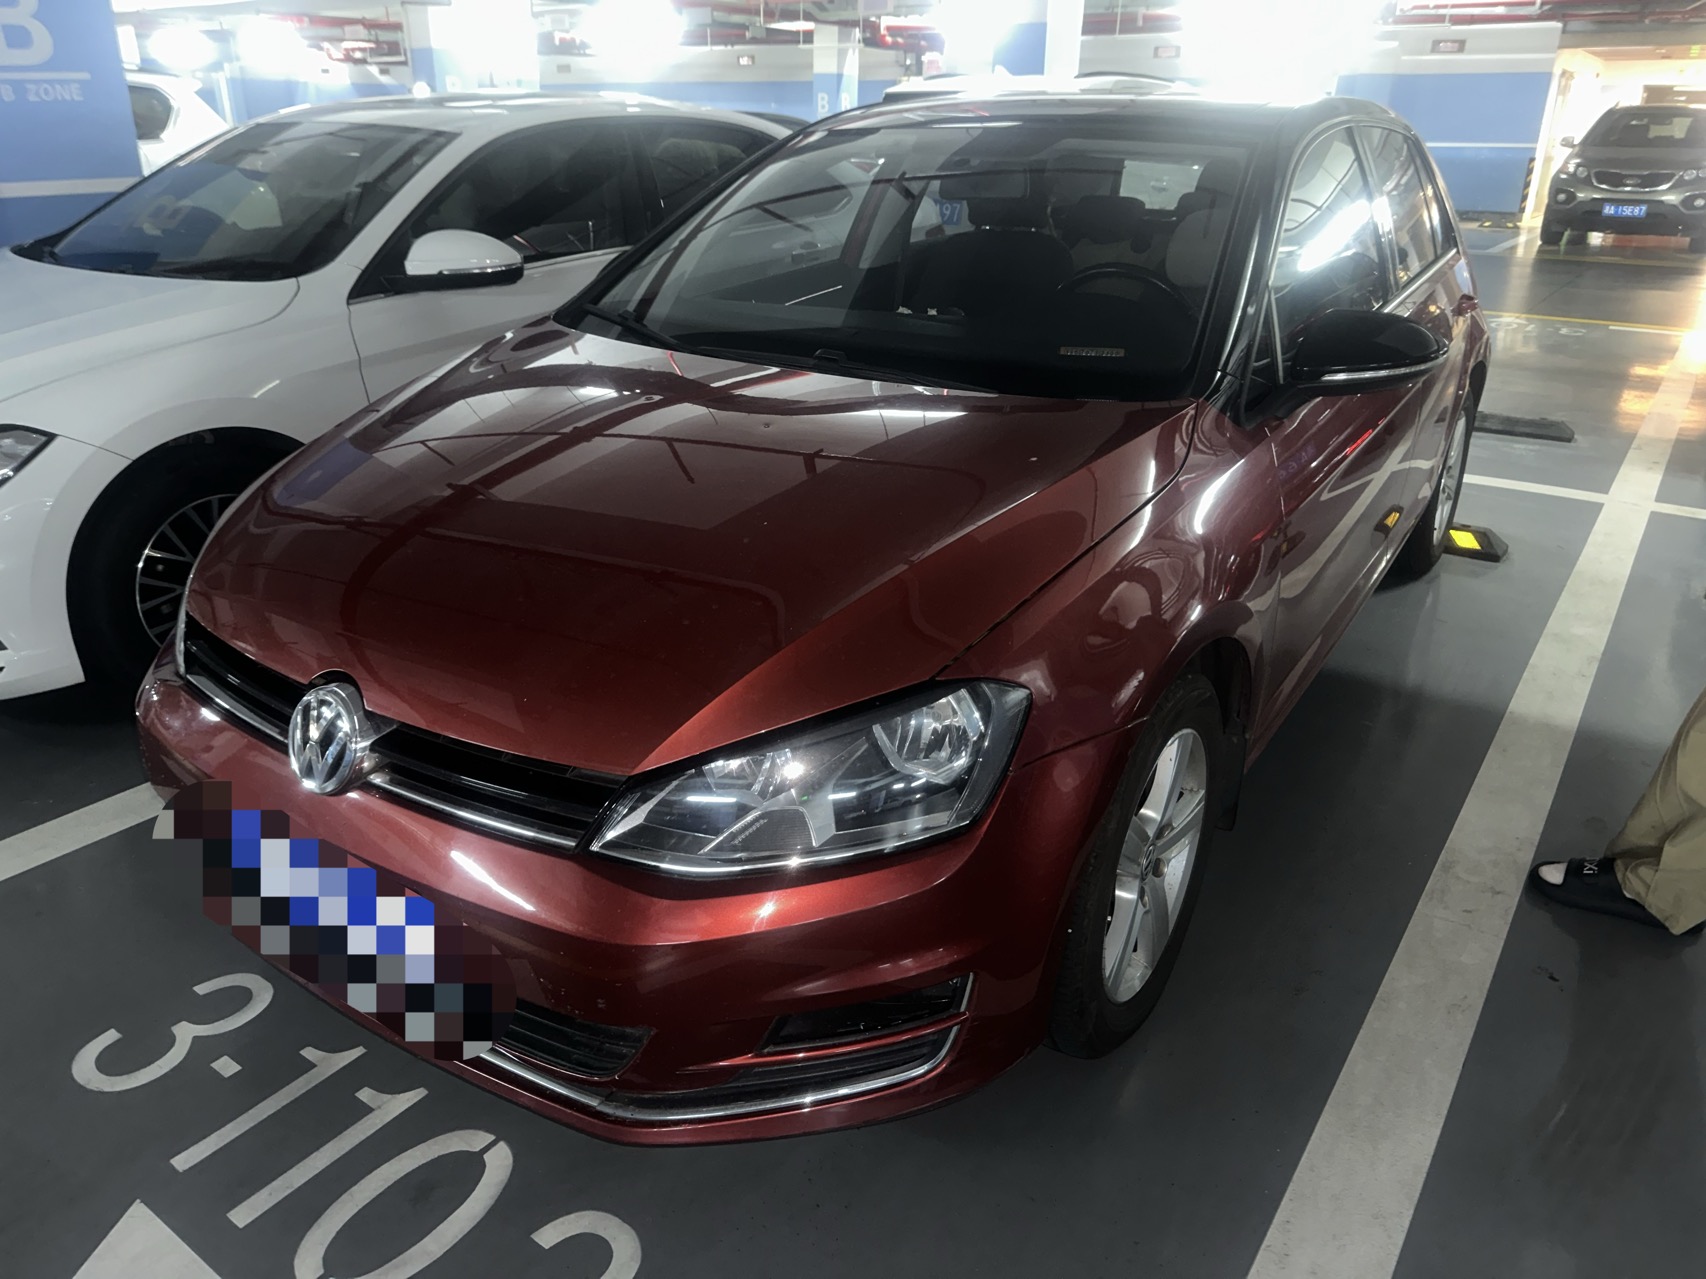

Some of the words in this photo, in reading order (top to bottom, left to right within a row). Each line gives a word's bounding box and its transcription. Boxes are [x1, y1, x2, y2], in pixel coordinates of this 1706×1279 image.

[0, 0, 54, 66] B
[24, 83, 84, 101] ZONE
[817, 92, 829, 112] B
